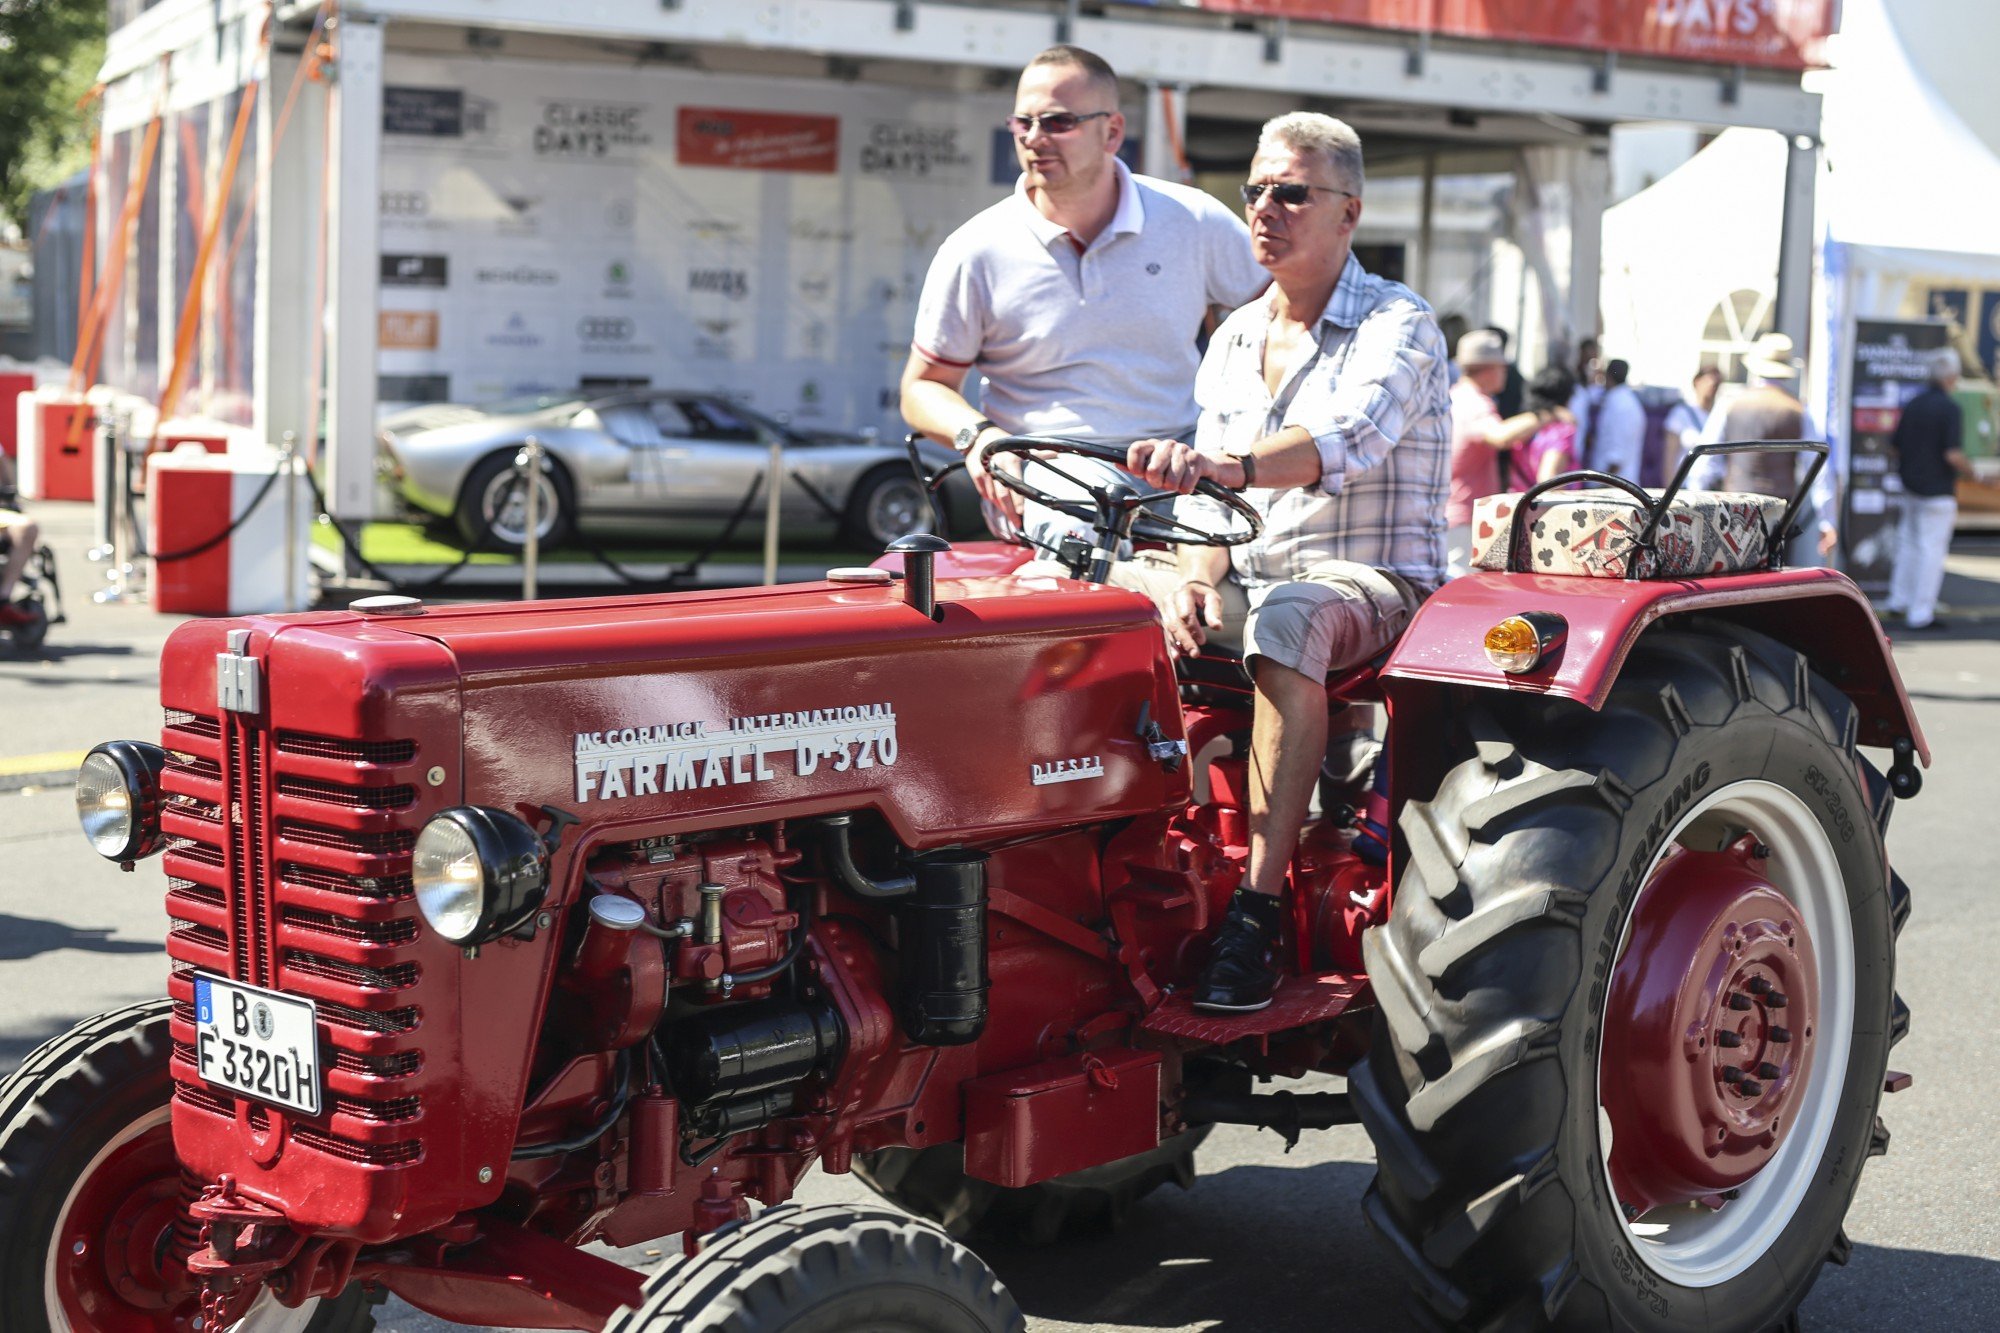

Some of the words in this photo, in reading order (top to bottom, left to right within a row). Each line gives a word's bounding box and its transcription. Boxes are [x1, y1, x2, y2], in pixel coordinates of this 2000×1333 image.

[544, 102, 642, 128] CLASSIC
[532, 124, 609, 158] DAYS
[860, 145, 930, 175] DAYS
[731, 702, 896, 736] INTERNATIONAL
[575, 743, 774, 803] FARMALL
[1031, 755, 1102, 782] DIESEL
[1588, 761, 1711, 1016] SUPERKING
[201, 1006, 209, 1020] D
[232, 991, 249, 1037] B
